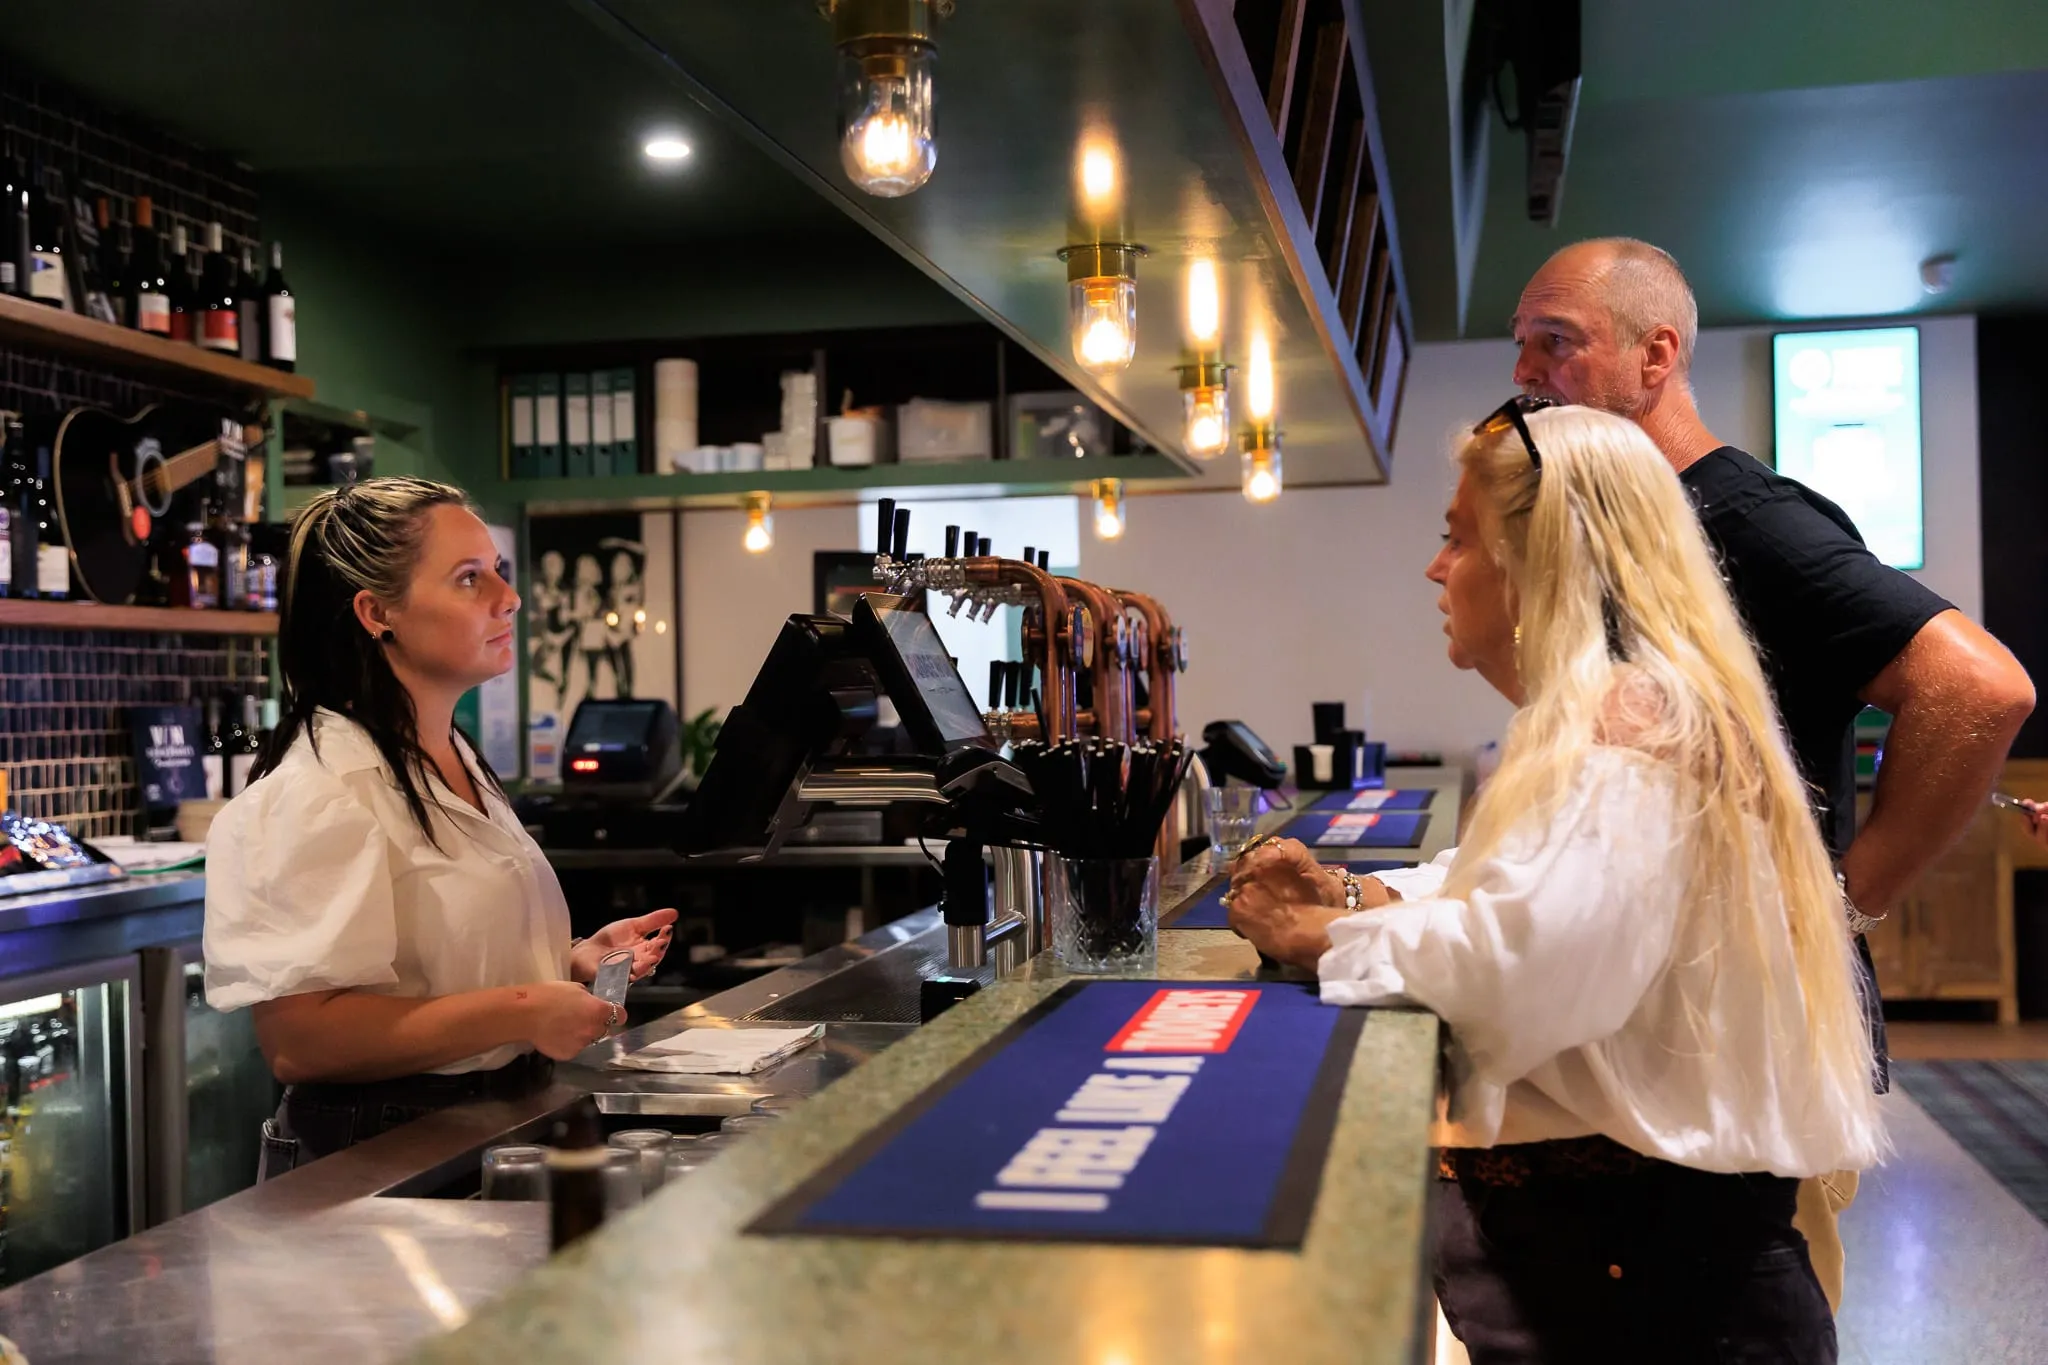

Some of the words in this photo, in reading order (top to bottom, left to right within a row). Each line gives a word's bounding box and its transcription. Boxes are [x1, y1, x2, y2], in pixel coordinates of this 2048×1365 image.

[1121, 990, 1248, 1051] TOOHEYS
[1103, 1055, 1205, 1073] A
[1055, 1073, 1191, 1123] LIKE
[996, 1125, 1157, 1189] FEEL
[976, 1190, 1109, 1212] I
